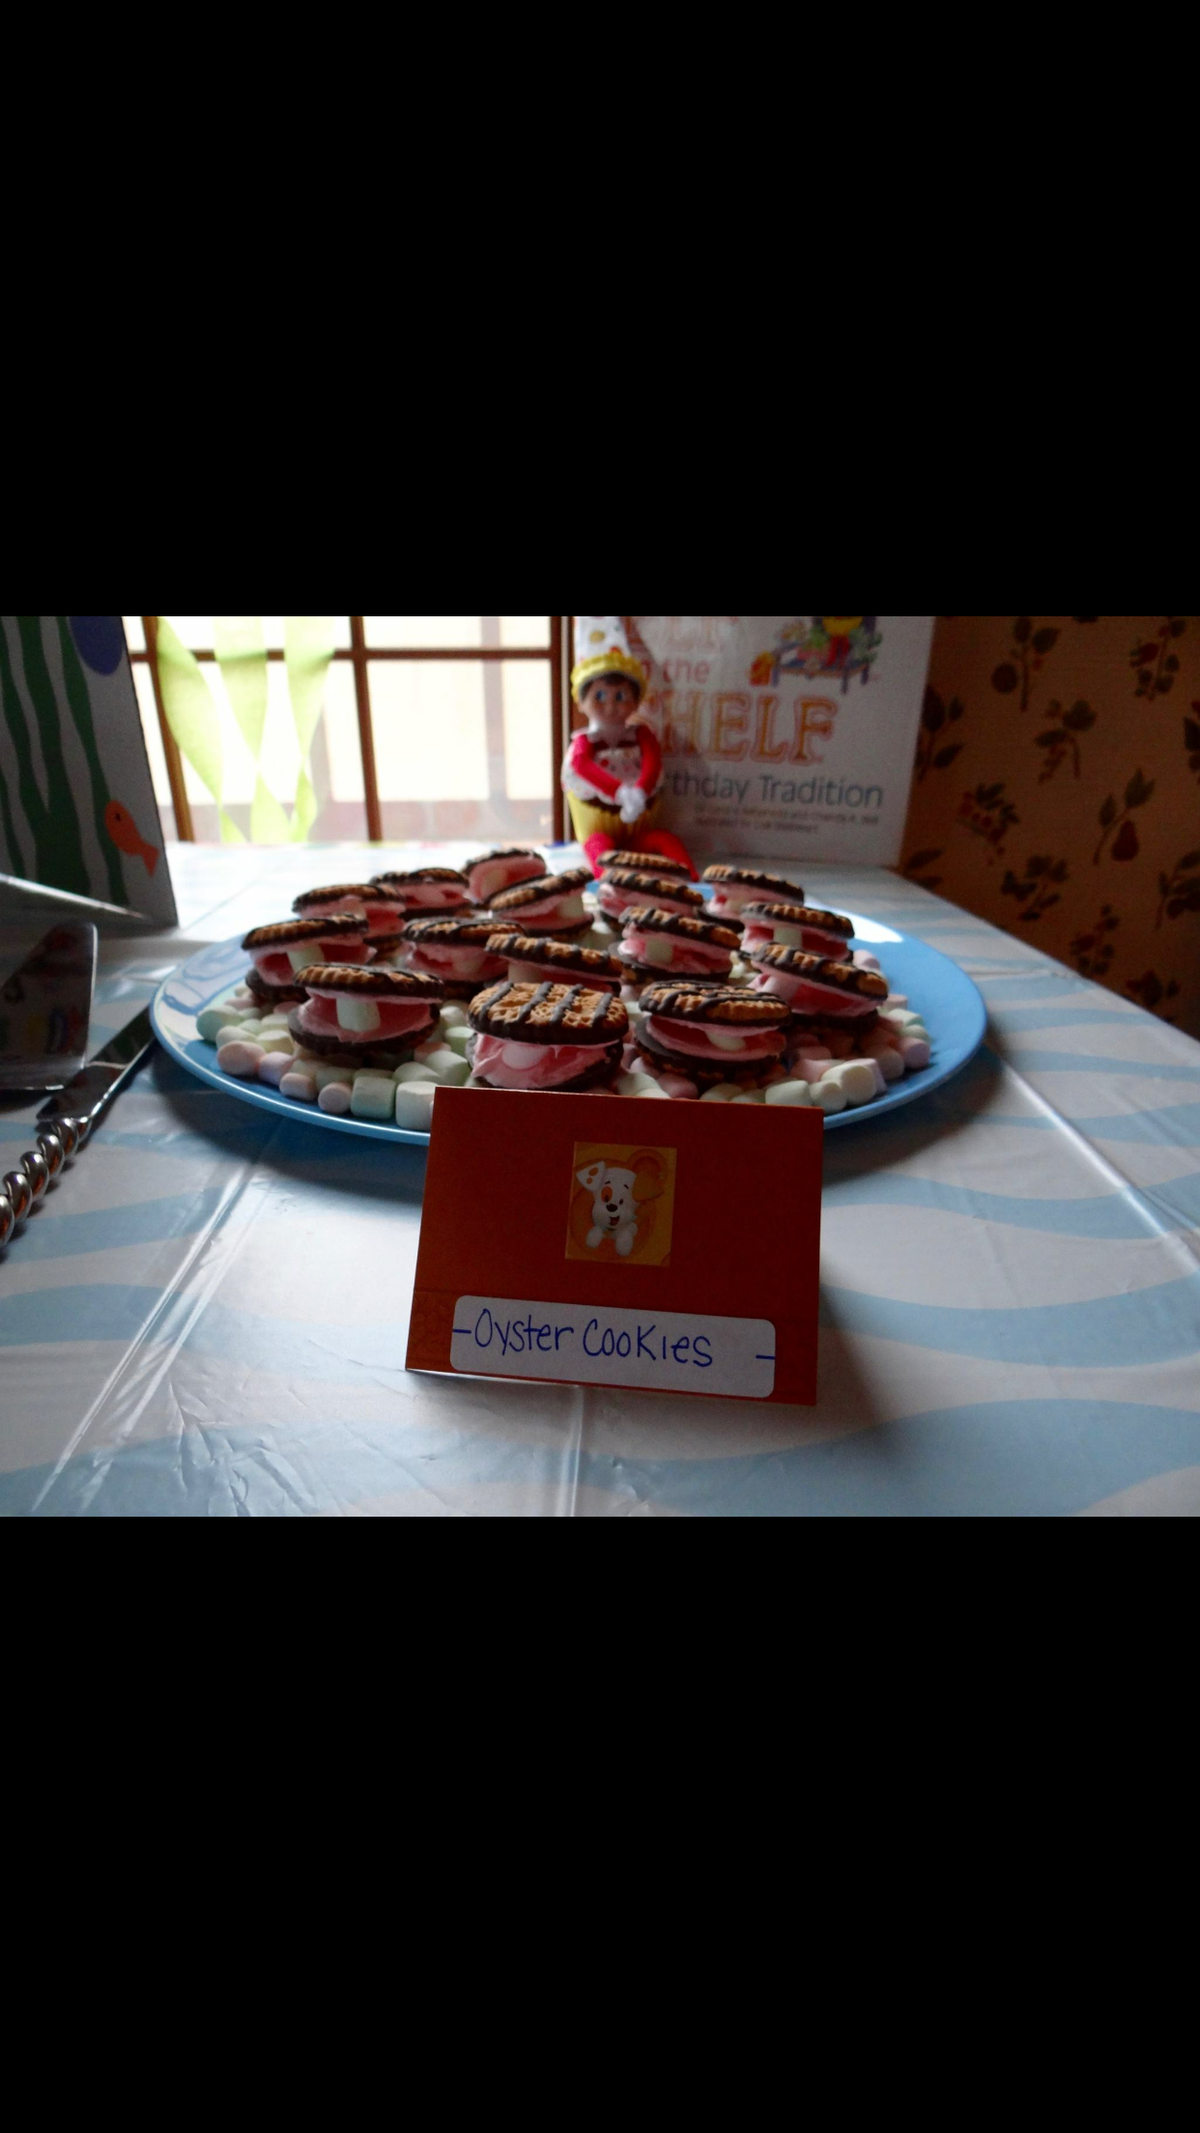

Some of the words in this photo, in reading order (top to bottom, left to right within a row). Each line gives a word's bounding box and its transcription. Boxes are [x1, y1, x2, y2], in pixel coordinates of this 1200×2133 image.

[661, 656, 710, 684] the
[758, 773, 884, 809] Tradition
[474, 1308, 574, 1357] Oyster
